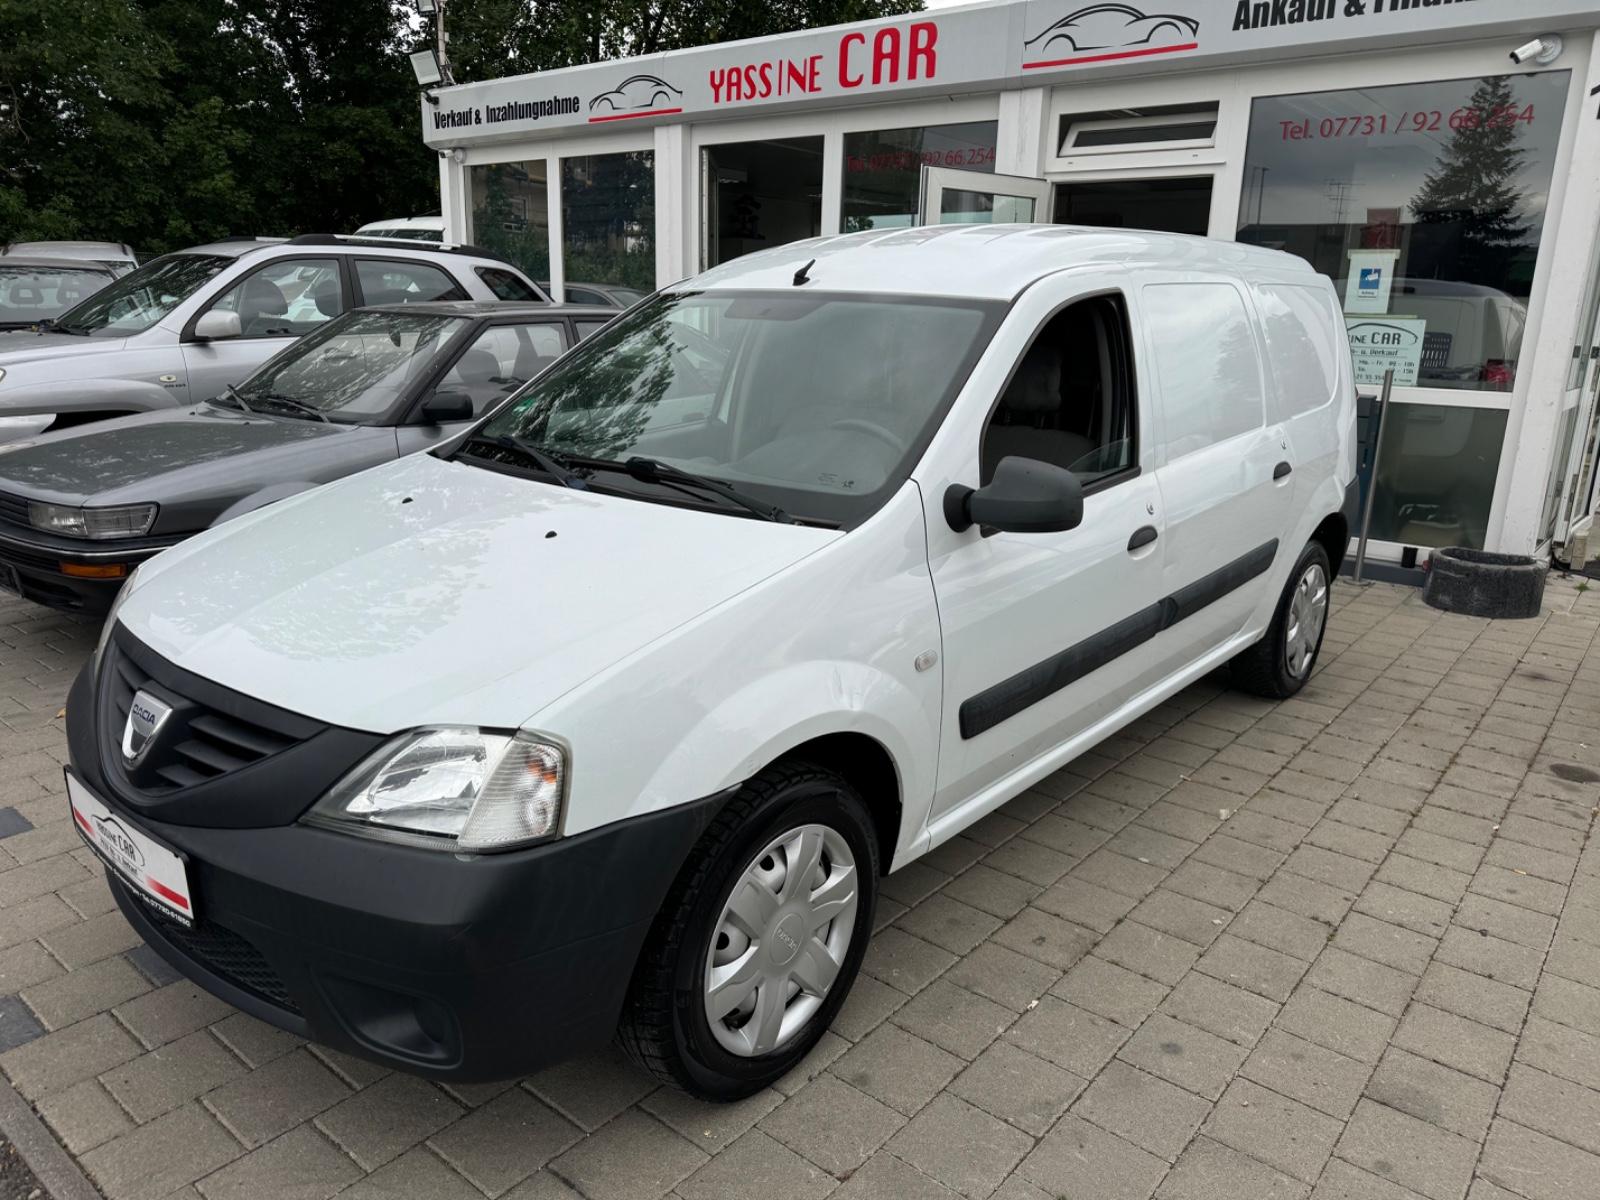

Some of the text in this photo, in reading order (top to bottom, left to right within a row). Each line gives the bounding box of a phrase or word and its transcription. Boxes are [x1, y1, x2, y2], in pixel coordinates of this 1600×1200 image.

[709, 21, 939, 104] YASSINE CAR
[433, 95, 580, 130] Verkauf & Inzahlungnahme
[1280, 119, 1313, 140] Tel.
[1320, 114, 1387, 138] 07731
[1394, 111, 1408, 135] /
[1412, 110, 1442, 132] 92
[1371, 331, 1402, 345] CAR
[132, 703, 155, 725] DACIA
[118, 834, 136, 863] CAR
